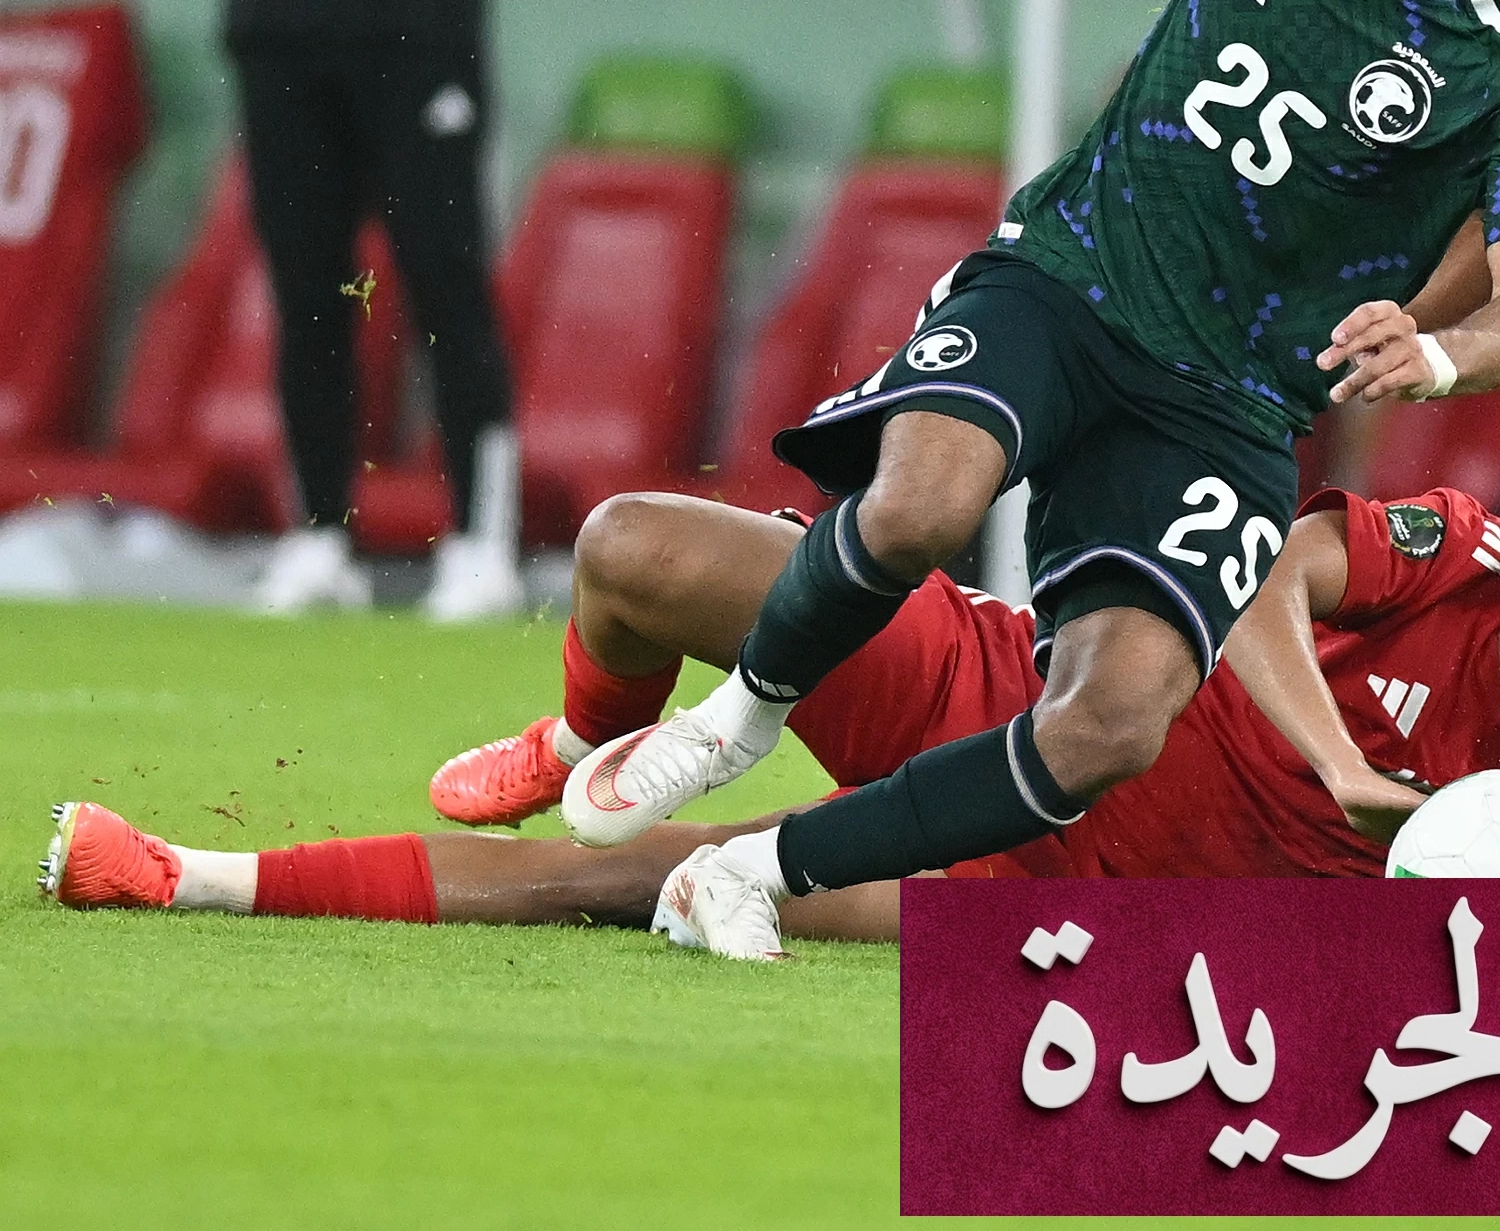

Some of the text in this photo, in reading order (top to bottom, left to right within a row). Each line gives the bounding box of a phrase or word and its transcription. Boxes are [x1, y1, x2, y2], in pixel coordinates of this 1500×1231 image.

[1184, 41, 1328, 187] 25
[1341, 122, 1378, 150] SAUDI
[1381, 110, 1403, 128] SAFF
[1157, 475, 1284, 610] 25
